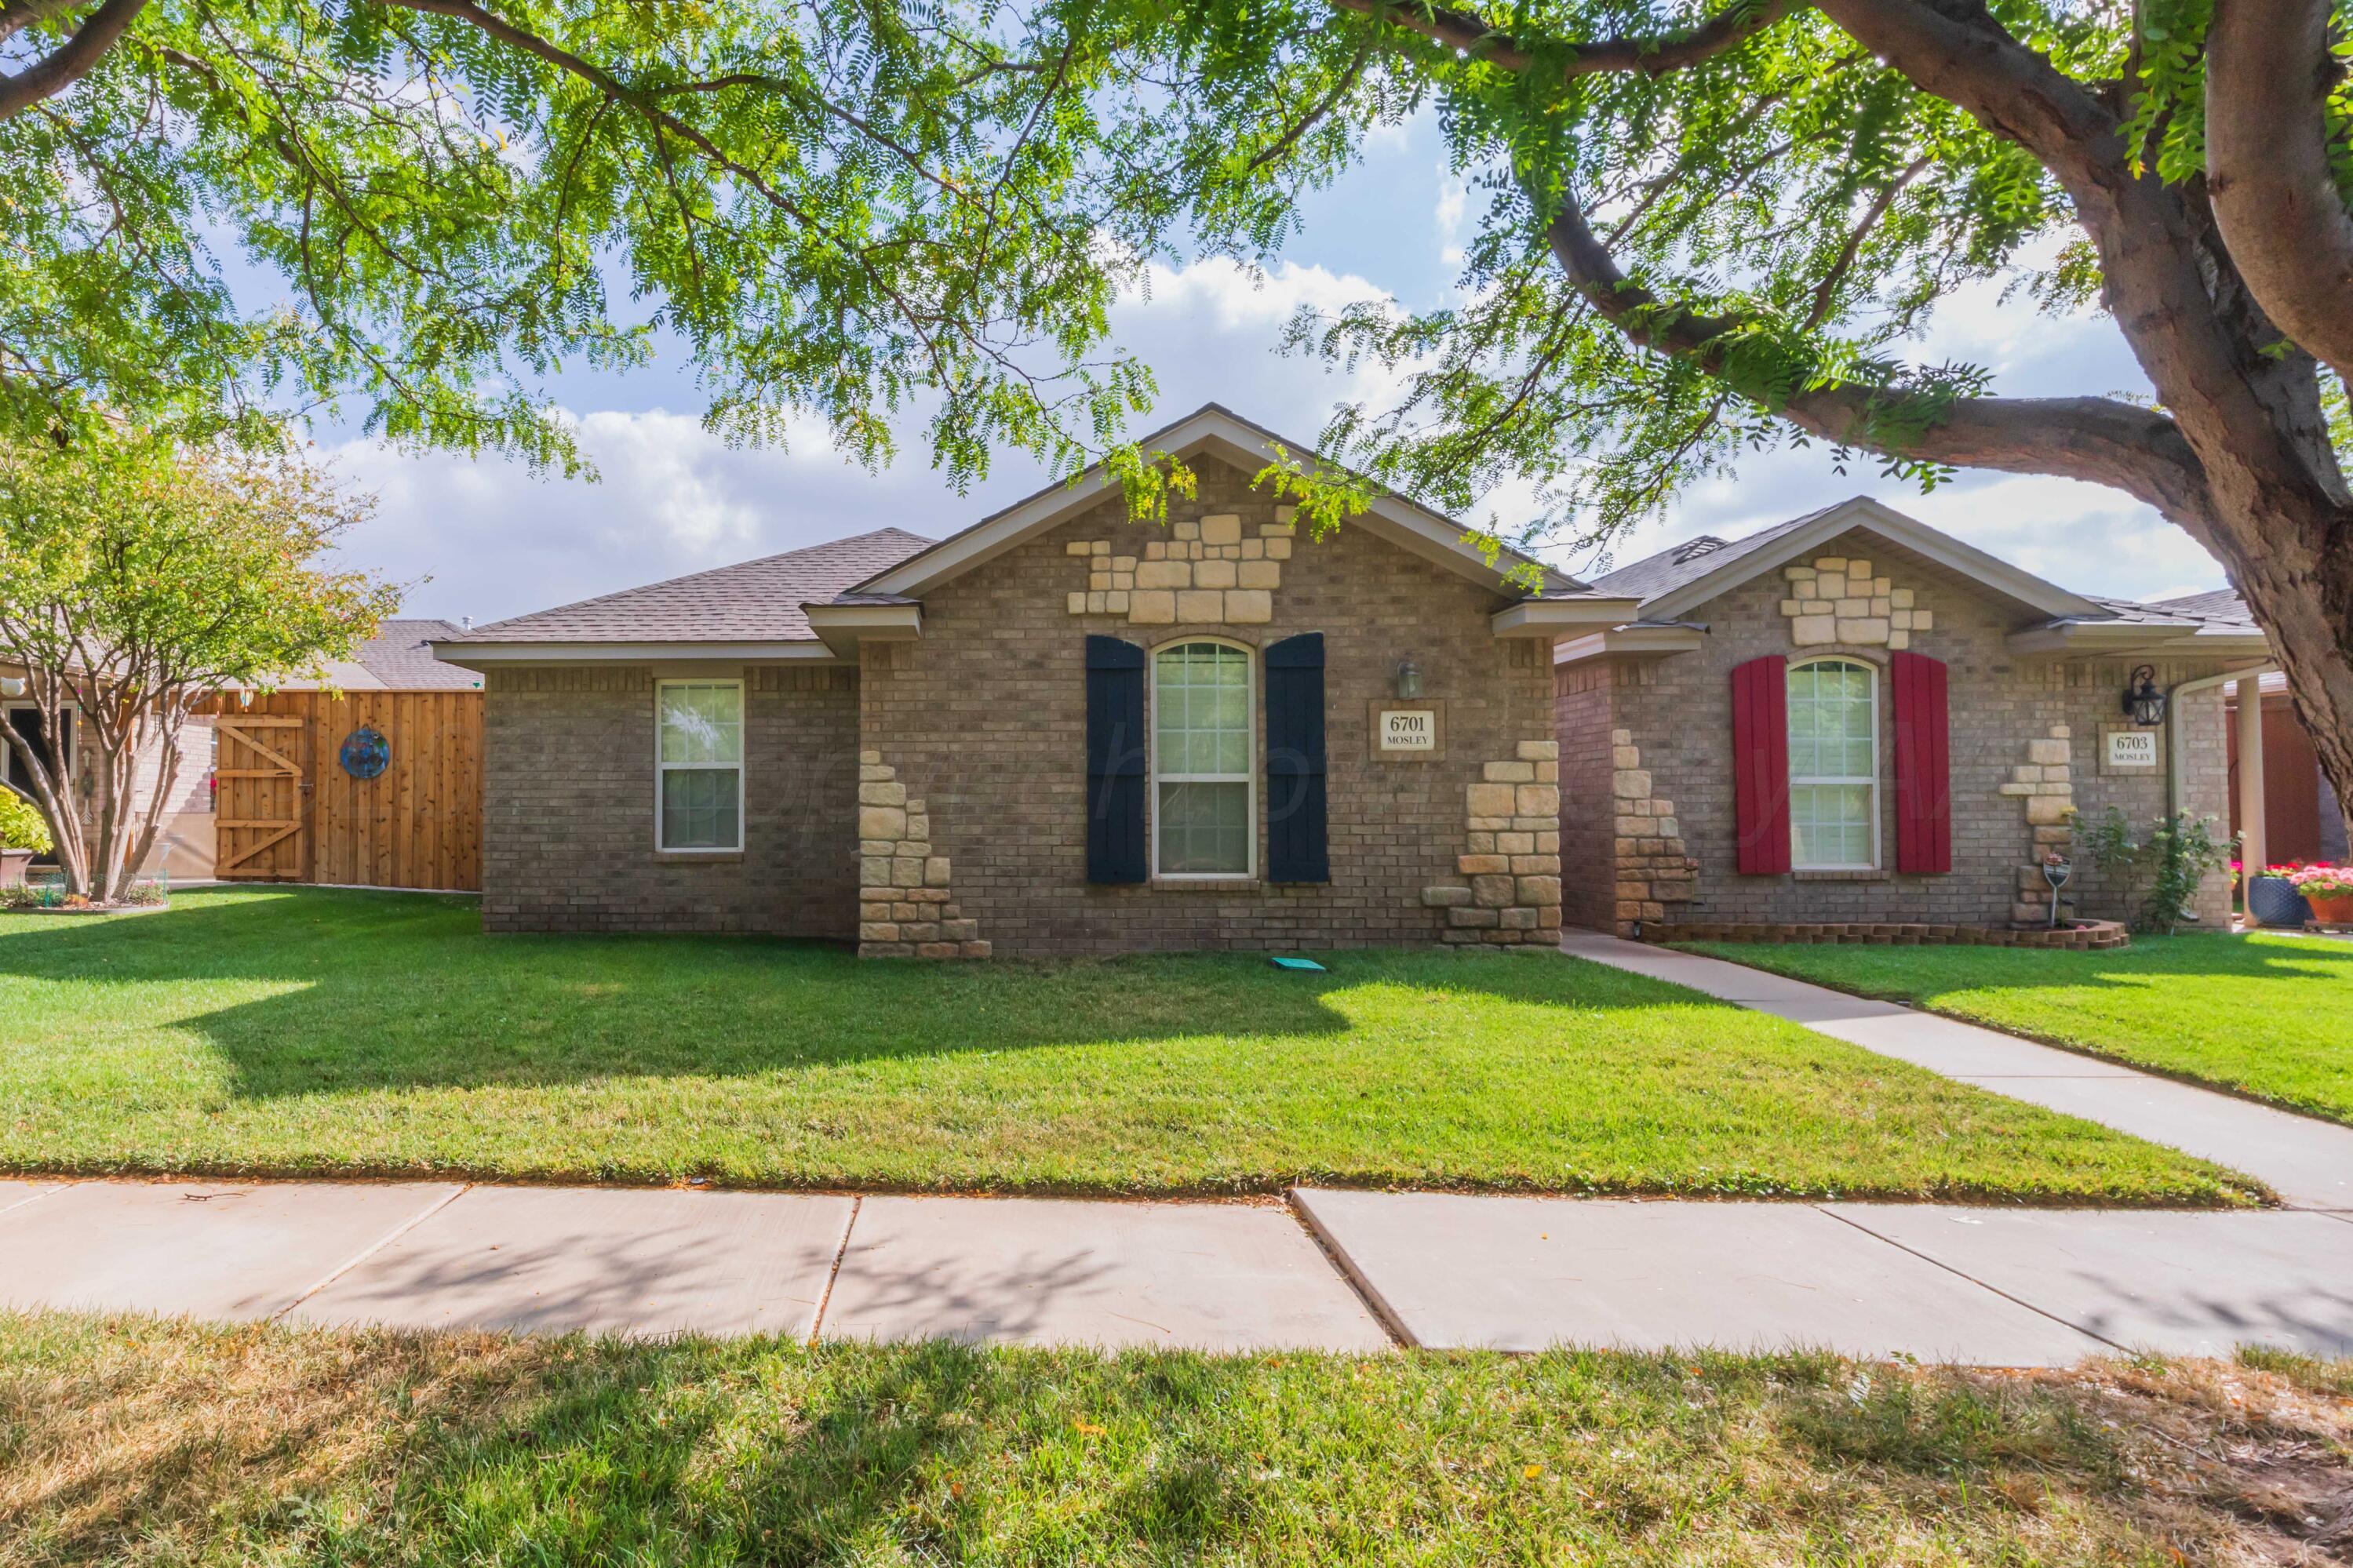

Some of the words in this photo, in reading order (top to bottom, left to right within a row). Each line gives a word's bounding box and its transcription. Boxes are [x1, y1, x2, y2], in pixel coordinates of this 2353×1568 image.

[1390, 716, 1425, 732] 6701
[1387, 736, 1428, 744] MOSLEY
[2117, 737, 2148, 750] 6703
